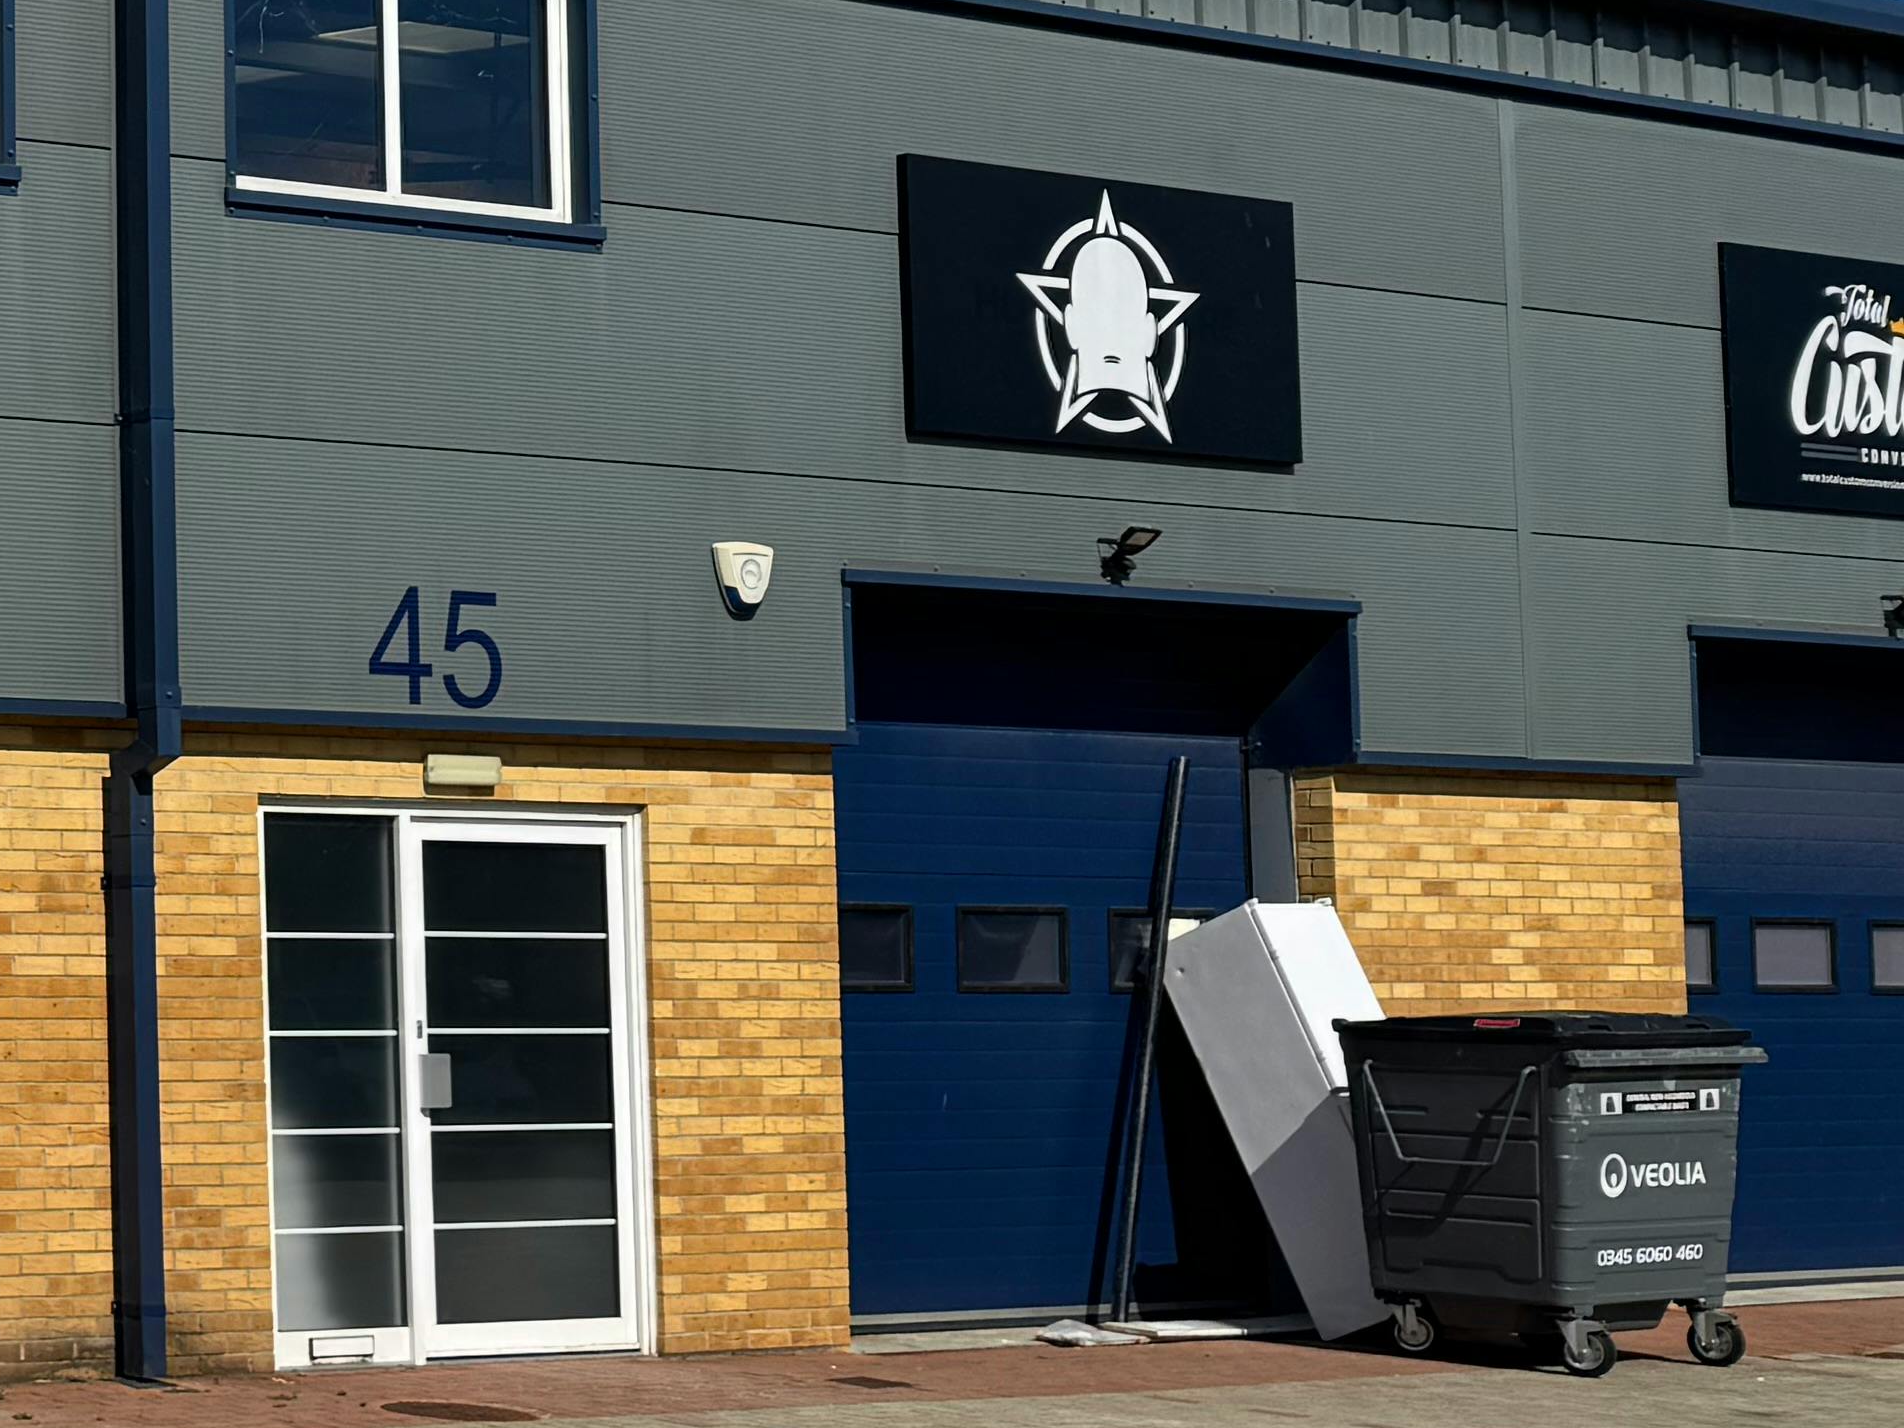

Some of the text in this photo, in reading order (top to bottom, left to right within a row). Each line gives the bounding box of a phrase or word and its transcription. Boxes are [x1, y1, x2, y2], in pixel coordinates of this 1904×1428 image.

[1825, 284, 1891, 327] Total
[1791, 316, 1904, 438] Cust
[368, 585, 503, 710] 45
[1630, 1161, 1706, 1188] VEOLIA
[1597, 1243, 1703, 1266] 0345 6060 460
